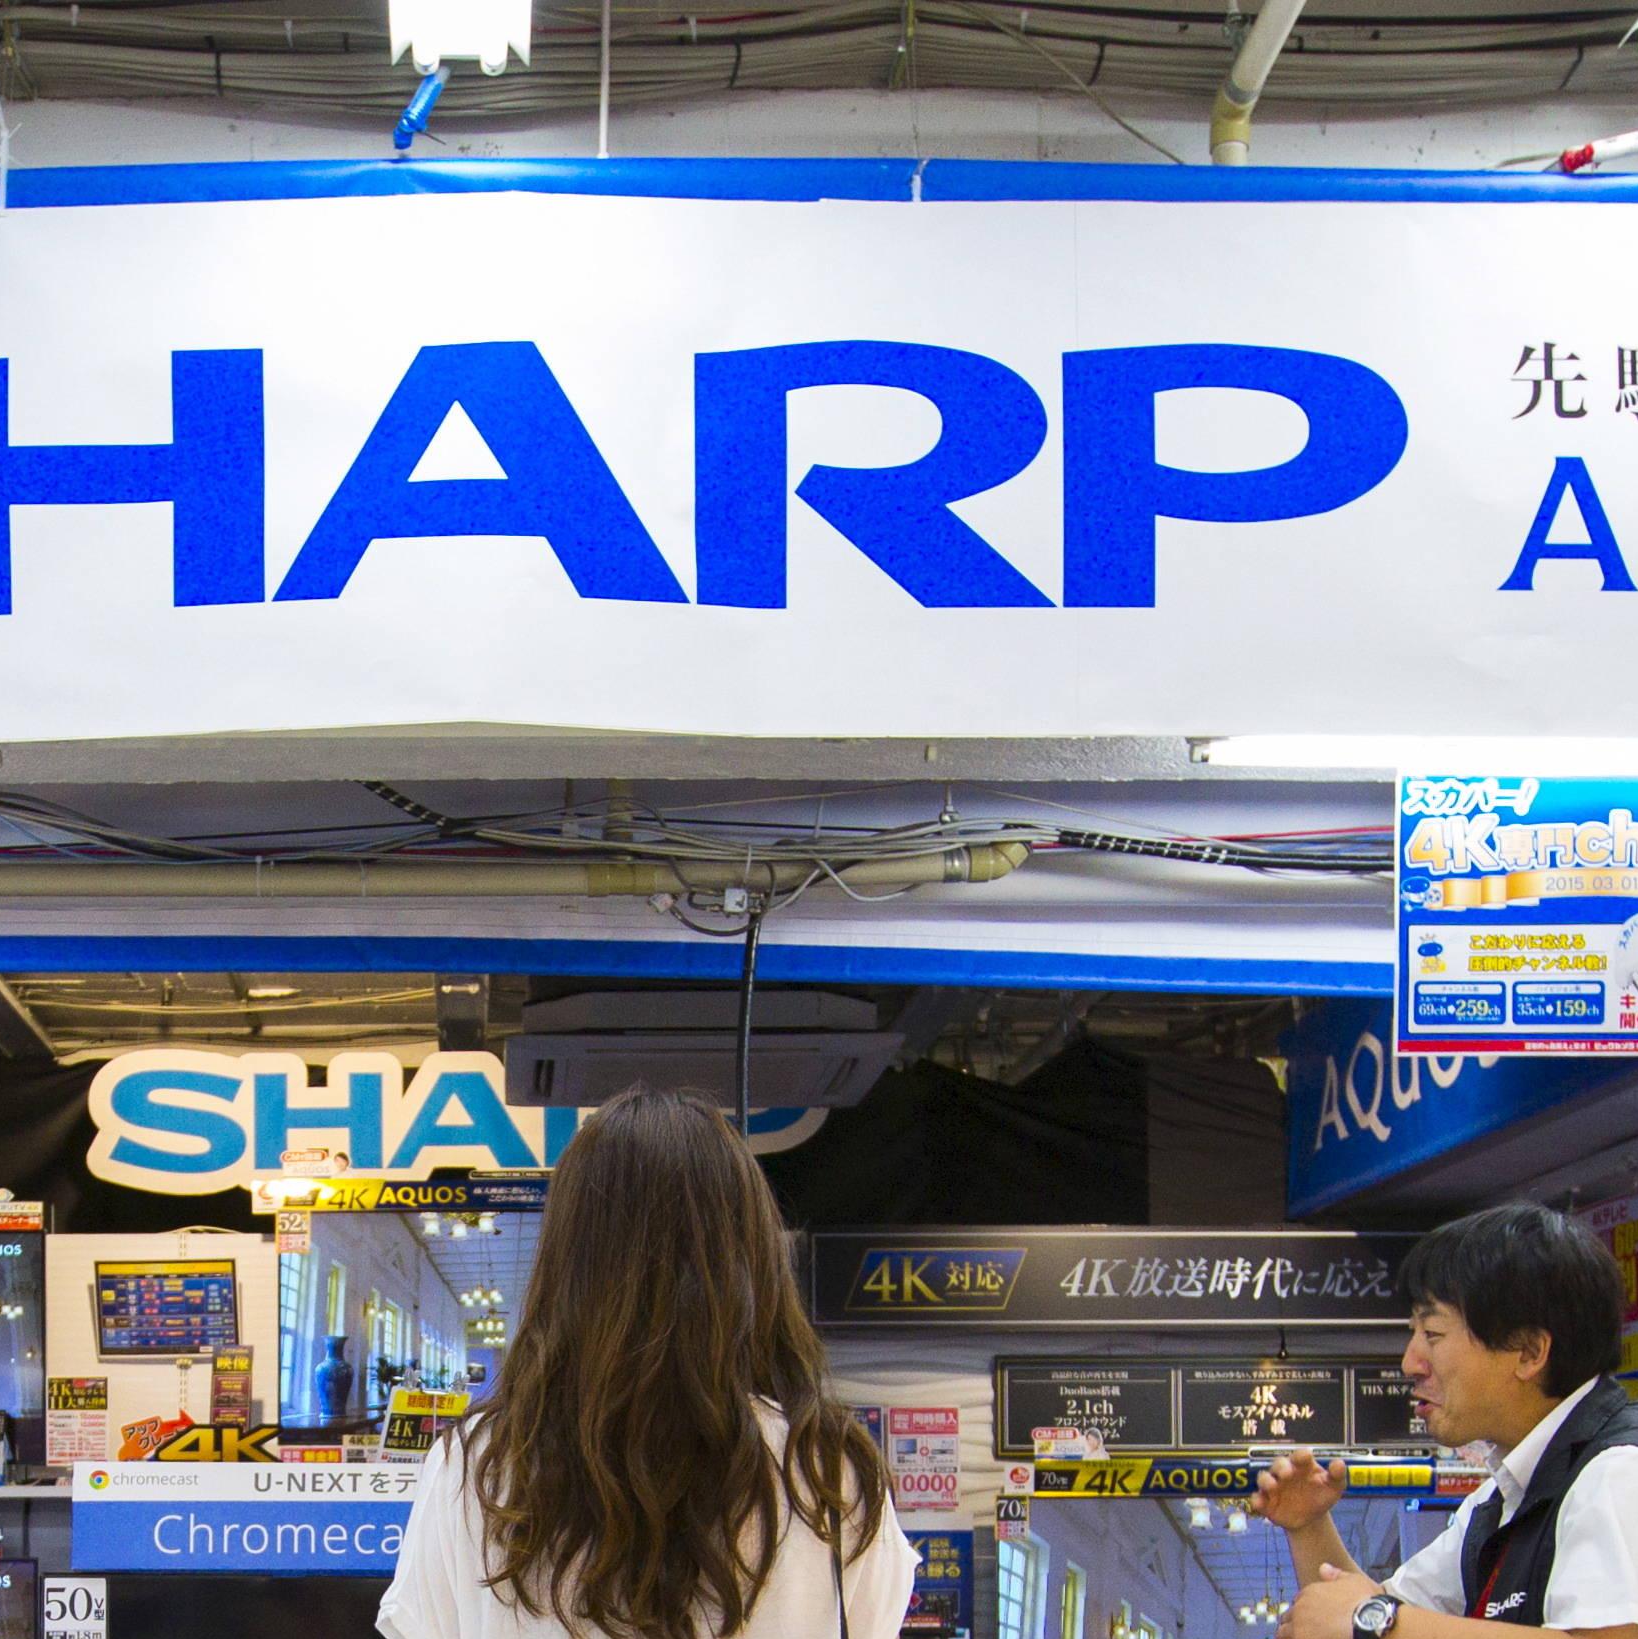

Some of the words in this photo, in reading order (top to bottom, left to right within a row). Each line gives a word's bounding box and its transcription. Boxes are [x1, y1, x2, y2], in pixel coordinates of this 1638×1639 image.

[1456, 999, 1501, 1017] 259ch
[1555, 999, 1600, 1017] 159ch
[108, 1068, 579, 1171] SHA
[328, 1188, 369, 1209] 4K
[379, 1186, 467, 1204] AQUOS
[863, 1254, 943, 1302] 4K
[944, 1262, 1005, 1292] 対応
[1060, 1256, 1395, 1299] 4K放送時代に応え
[1066, 1400, 1114, 1415] 2.1ch
[1250, 1385, 1277, 1403] 4K
[159, 1427, 280, 1461] 4K
[112, 1471, 199, 1486] chromecast
[254, 1471, 363, 1494] U-NEXT
[1084, 1469, 1134, 1495] 4K
[1149, 1467, 1249, 1489] AQUOS
[997, 1499, 1021, 1518] 70
[153, 1512, 403, 1556] Chromeca
[43, 1587, 93, 1622] 50
